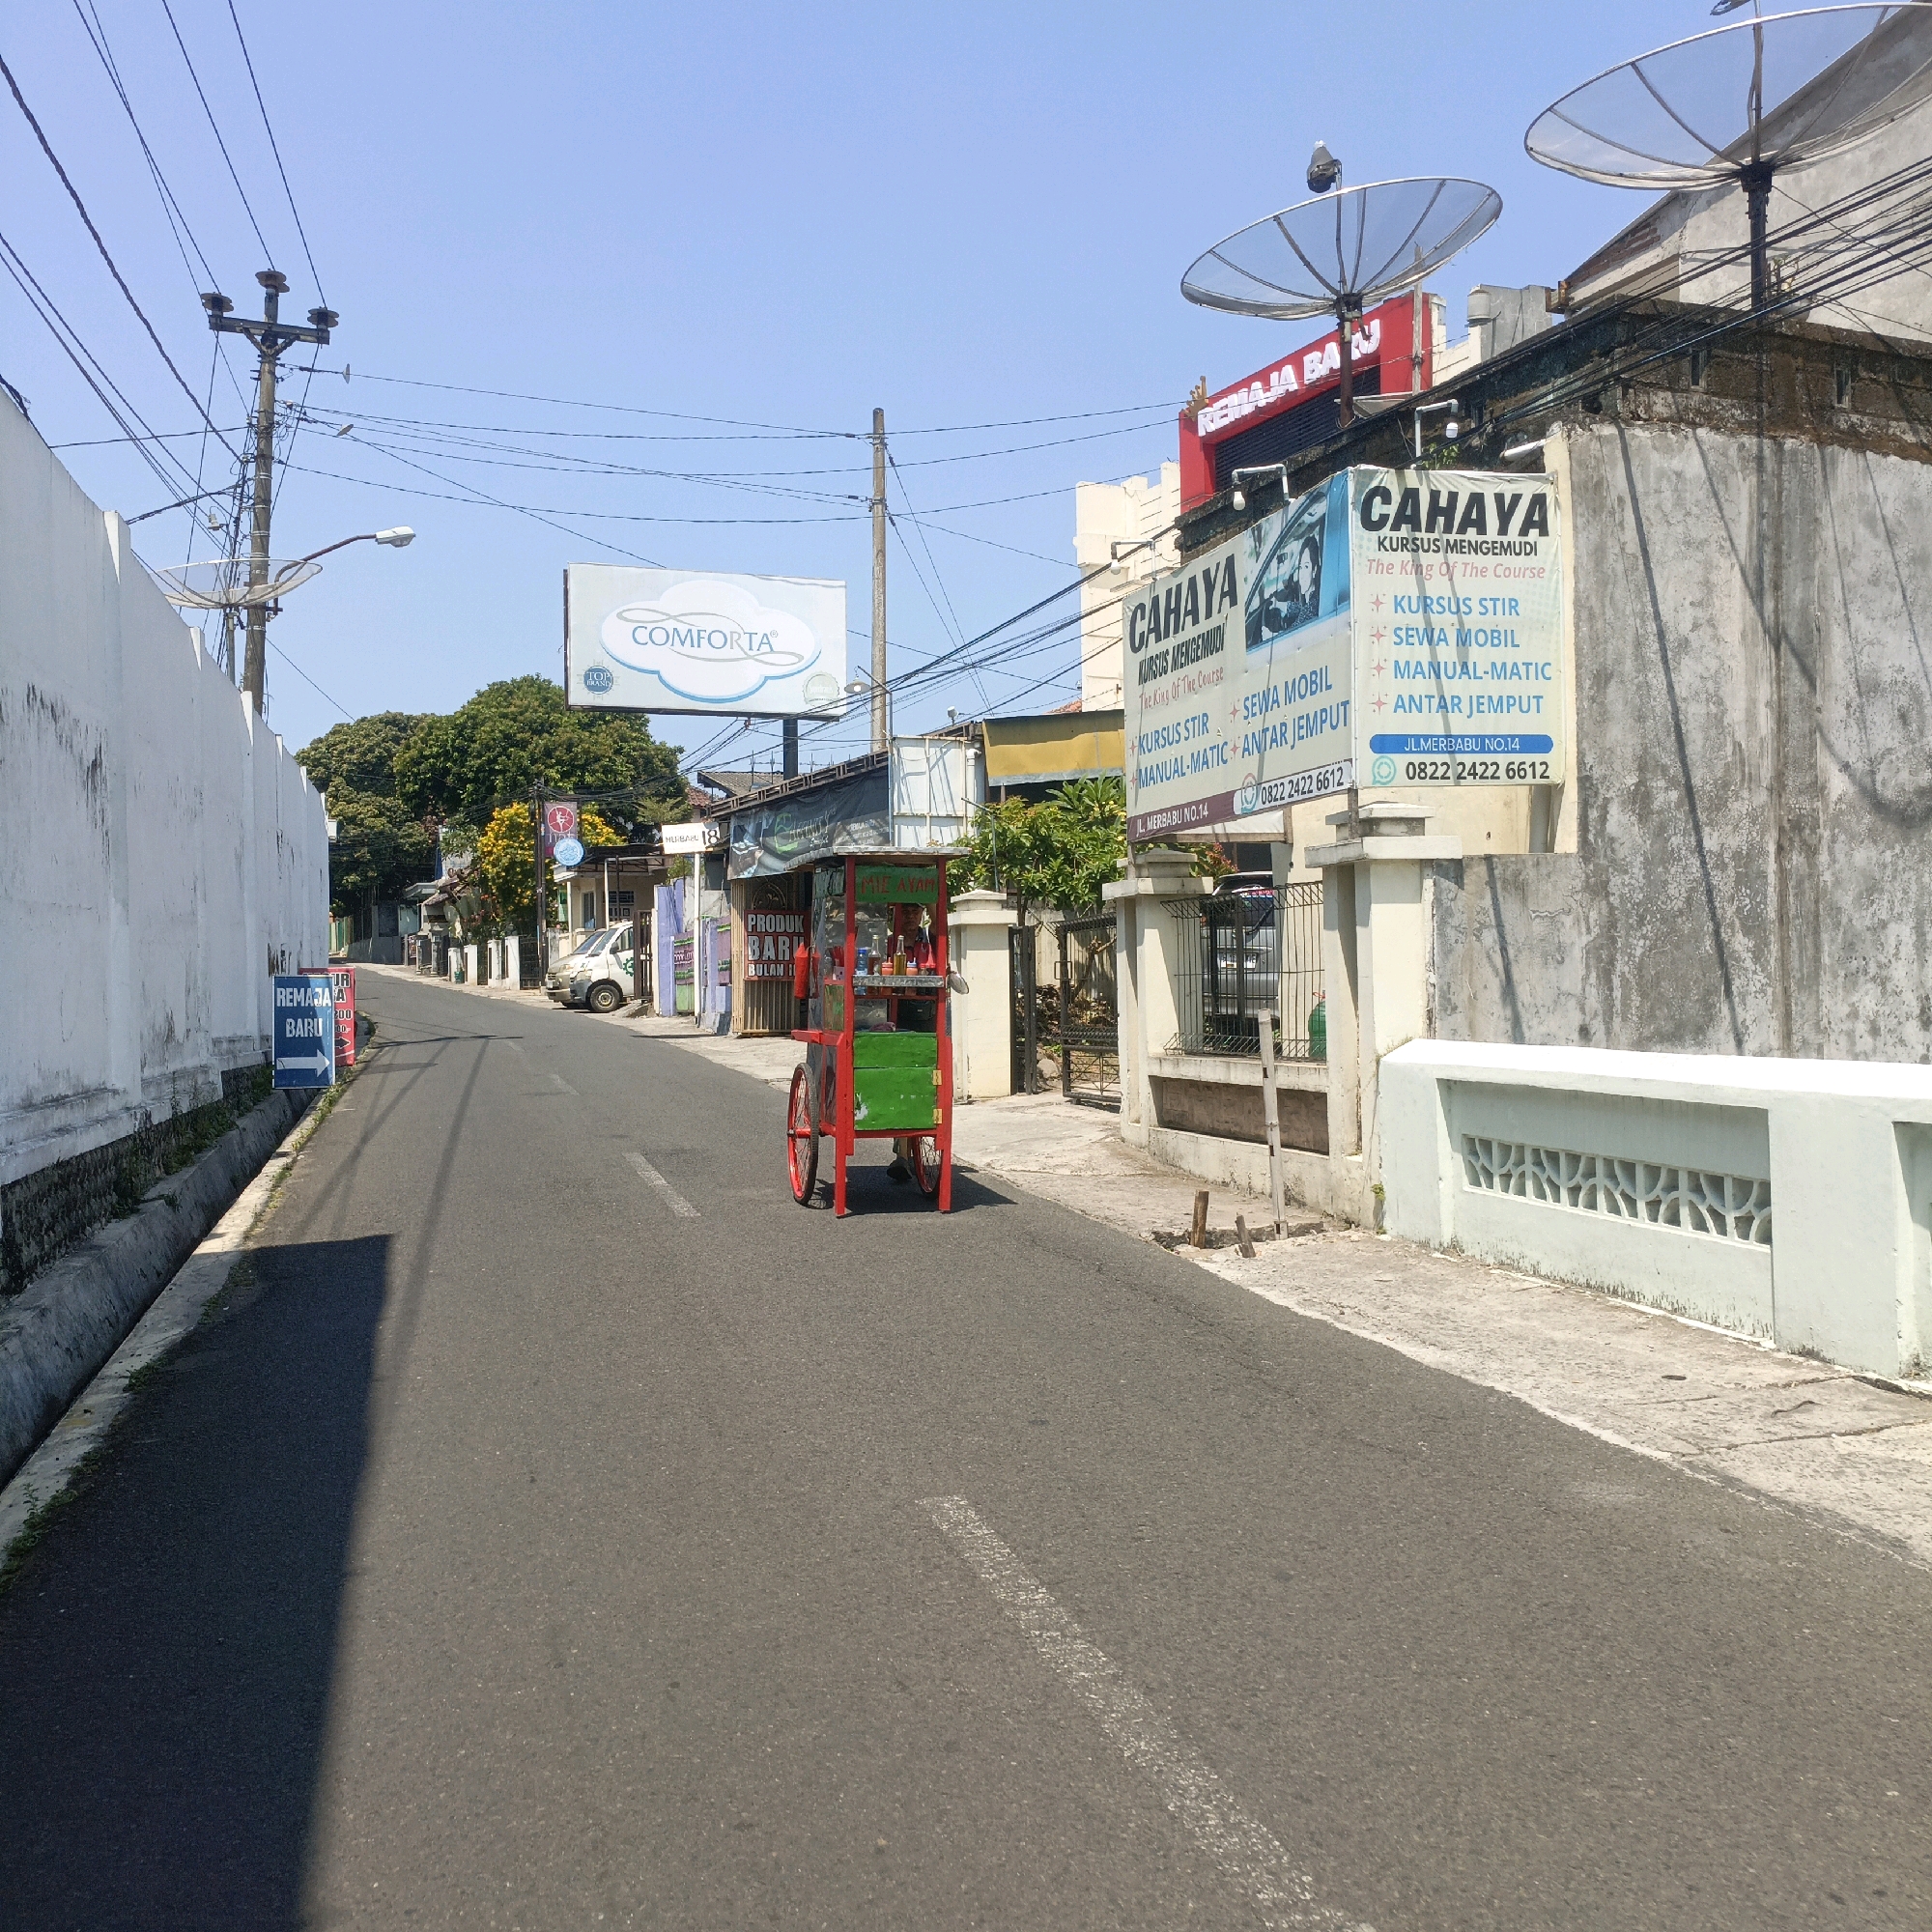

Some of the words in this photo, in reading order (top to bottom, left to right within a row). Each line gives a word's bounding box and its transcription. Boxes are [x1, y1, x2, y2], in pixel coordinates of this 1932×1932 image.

[1198, 364, 1298, 437] REMAJA
[1360, 485, 1549, 537] CAHAYA
[1378, 535, 1441, 554] KURSUS
[1445, 538, 1538, 556] MENGEMUDI
[1367, 559, 1395, 575] The
[1400, 560, 1434, 582] King
[1438, 561, 1458, 582] Of
[1462, 562, 1489, 579] The
[1493, 563, 1546, 579] Course
[1129, 554, 1237, 653] CAHAYA
[1394, 595, 1473, 616] KURSUS
[1478, 597, 1520, 616] STIR
[1393, 627, 1449, 647] SEWA
[1456, 629, 1520, 648] MOBIL
[1138, 648, 1170, 686] KURSUS
[1171, 622, 1225, 673] MENGEMUDI
[586, 671, 611, 681] TOP
[1393, 660, 1552, 681] MANUAL-MATIC
[1139, 693, 1152, 710] The
[1153, 687, 1170, 706] King
[1172, 677, 1180, 699] Of
[1181, 675, 1196, 695] The
[1198, 667, 1224, 689] Course
[1243, 684, 1280, 721] SEWA
[1285, 665, 1332, 706] MOBIL
[1393, 694, 1463, 714] ANTAR
[1466, 695, 1544, 719] JEMPUT
[1140, 722, 1181, 756] KURSUS
[1183, 712, 1209, 742] STIR
[1241, 722, 1289, 759] ANTAR
[1291, 699, 1350, 751] JEMPUT
[1485, 738, 1520, 751] NO.14
[1139, 741, 1229, 789] MANUAL-MATIC
[1406, 761, 1451, 781] 0822
[1456, 761, 1501, 781] 2422
[1505, 761, 1550, 780] 6612
[1261, 781, 1286, 806] 0822
[1288, 775, 1314, 799] 2422
[1316, 766, 1345, 792] 6612
[1136, 818, 1147, 838] JL.
[1147, 808, 1182, 831] MERBABU
[1183, 803, 1209, 823] NO.14
[701, 829, 719, 846] 18
[861, 875, 892, 895] MIE
[896, 877, 936, 894] AYAM
[747, 914, 805, 933] PRODUK
[748, 963, 784, 977] BULAN
[276, 987, 332, 1007] REMAJA
[285, 1017, 324, 1037] BARU
